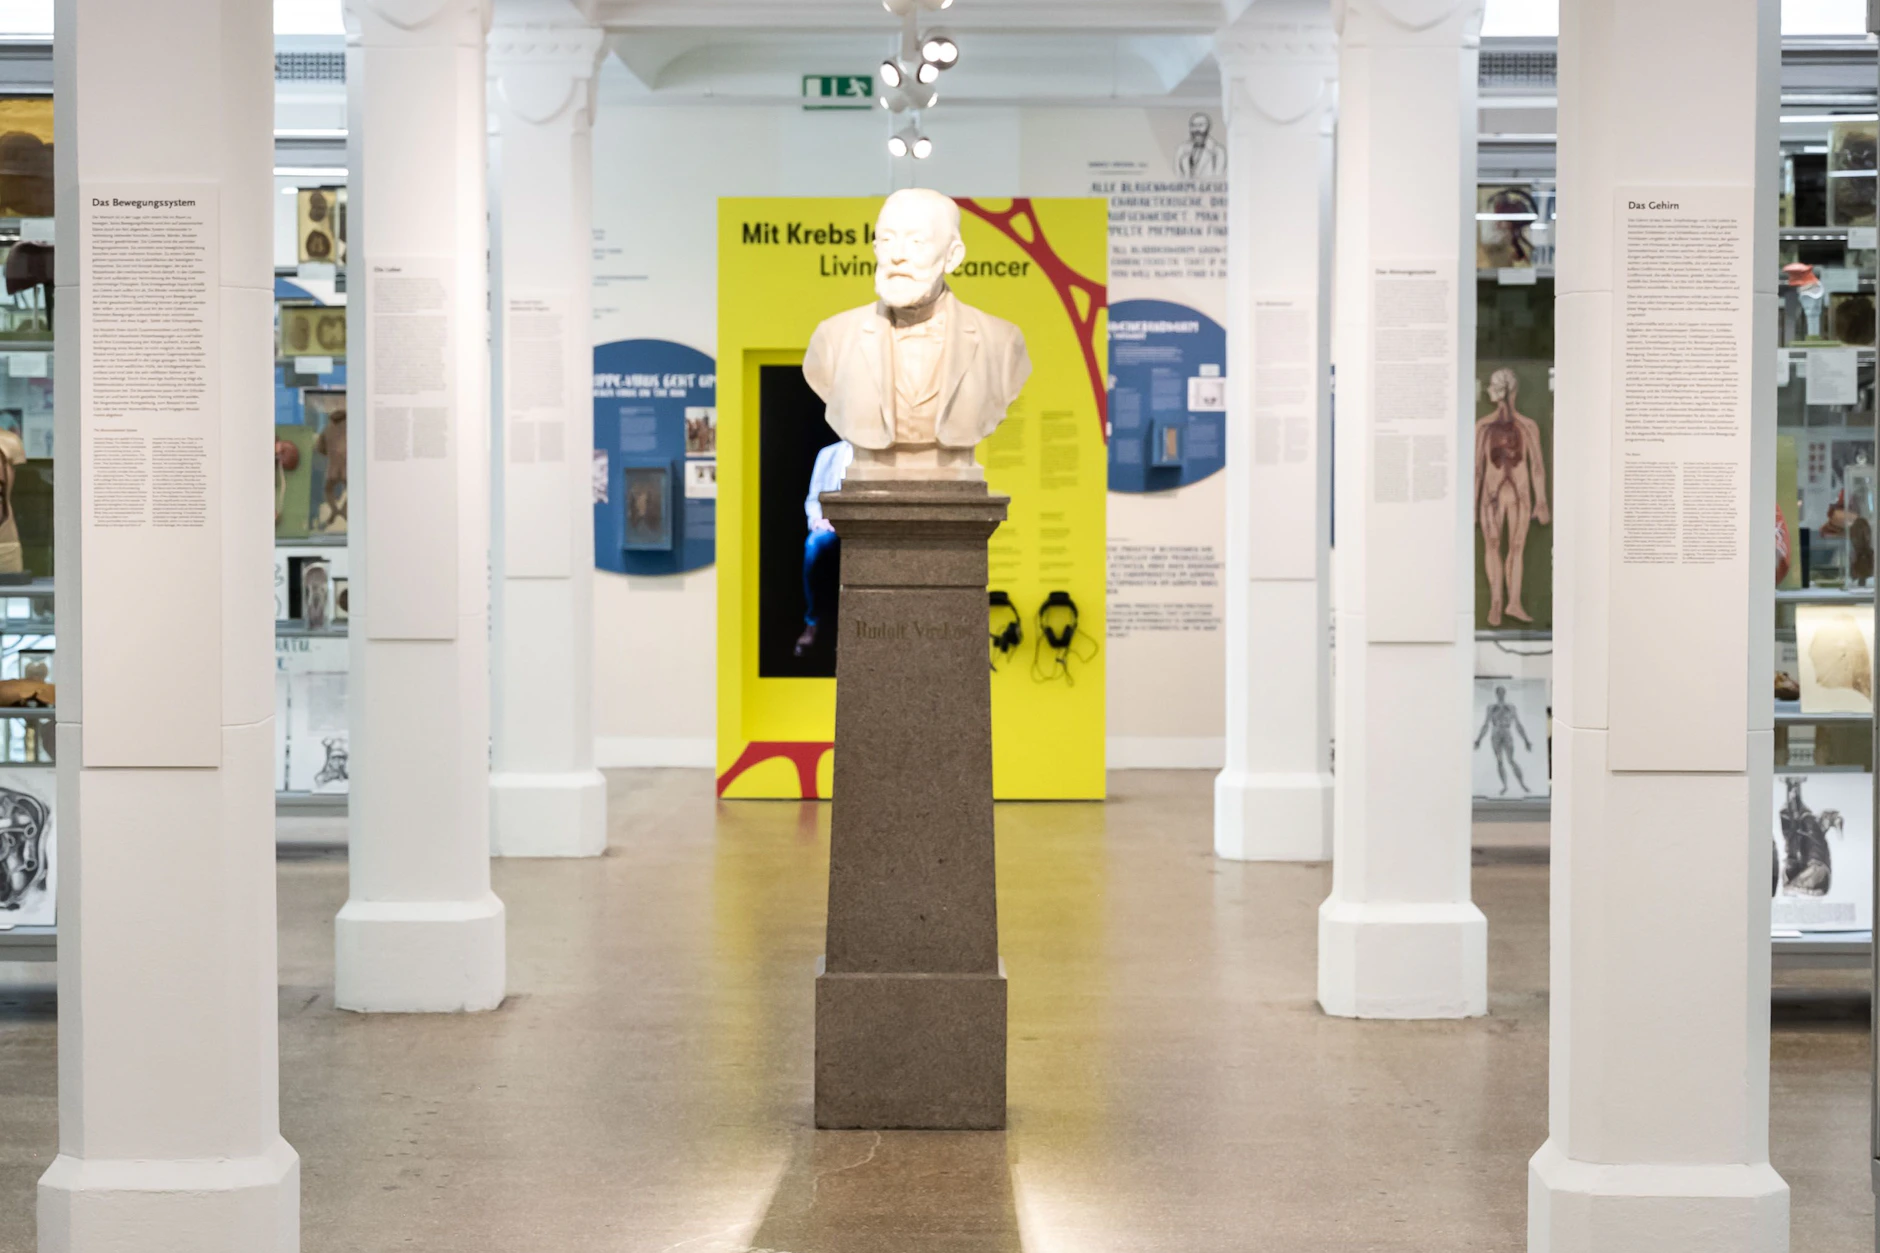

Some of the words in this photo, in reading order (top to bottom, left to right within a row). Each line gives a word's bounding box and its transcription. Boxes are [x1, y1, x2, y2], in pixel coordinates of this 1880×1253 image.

[92, 198, 110, 207] Das
[112, 198, 196, 209] Bewegungssystem
[1628, 201, 1646, 210] Das
[1648, 201, 1680, 210] Gehirn
[742, 223, 779, 244] Mit
[787, 223, 856, 244] Krebs
[820, 255, 876, 276] Livin
[951, 259, 1029, 276] cancer
